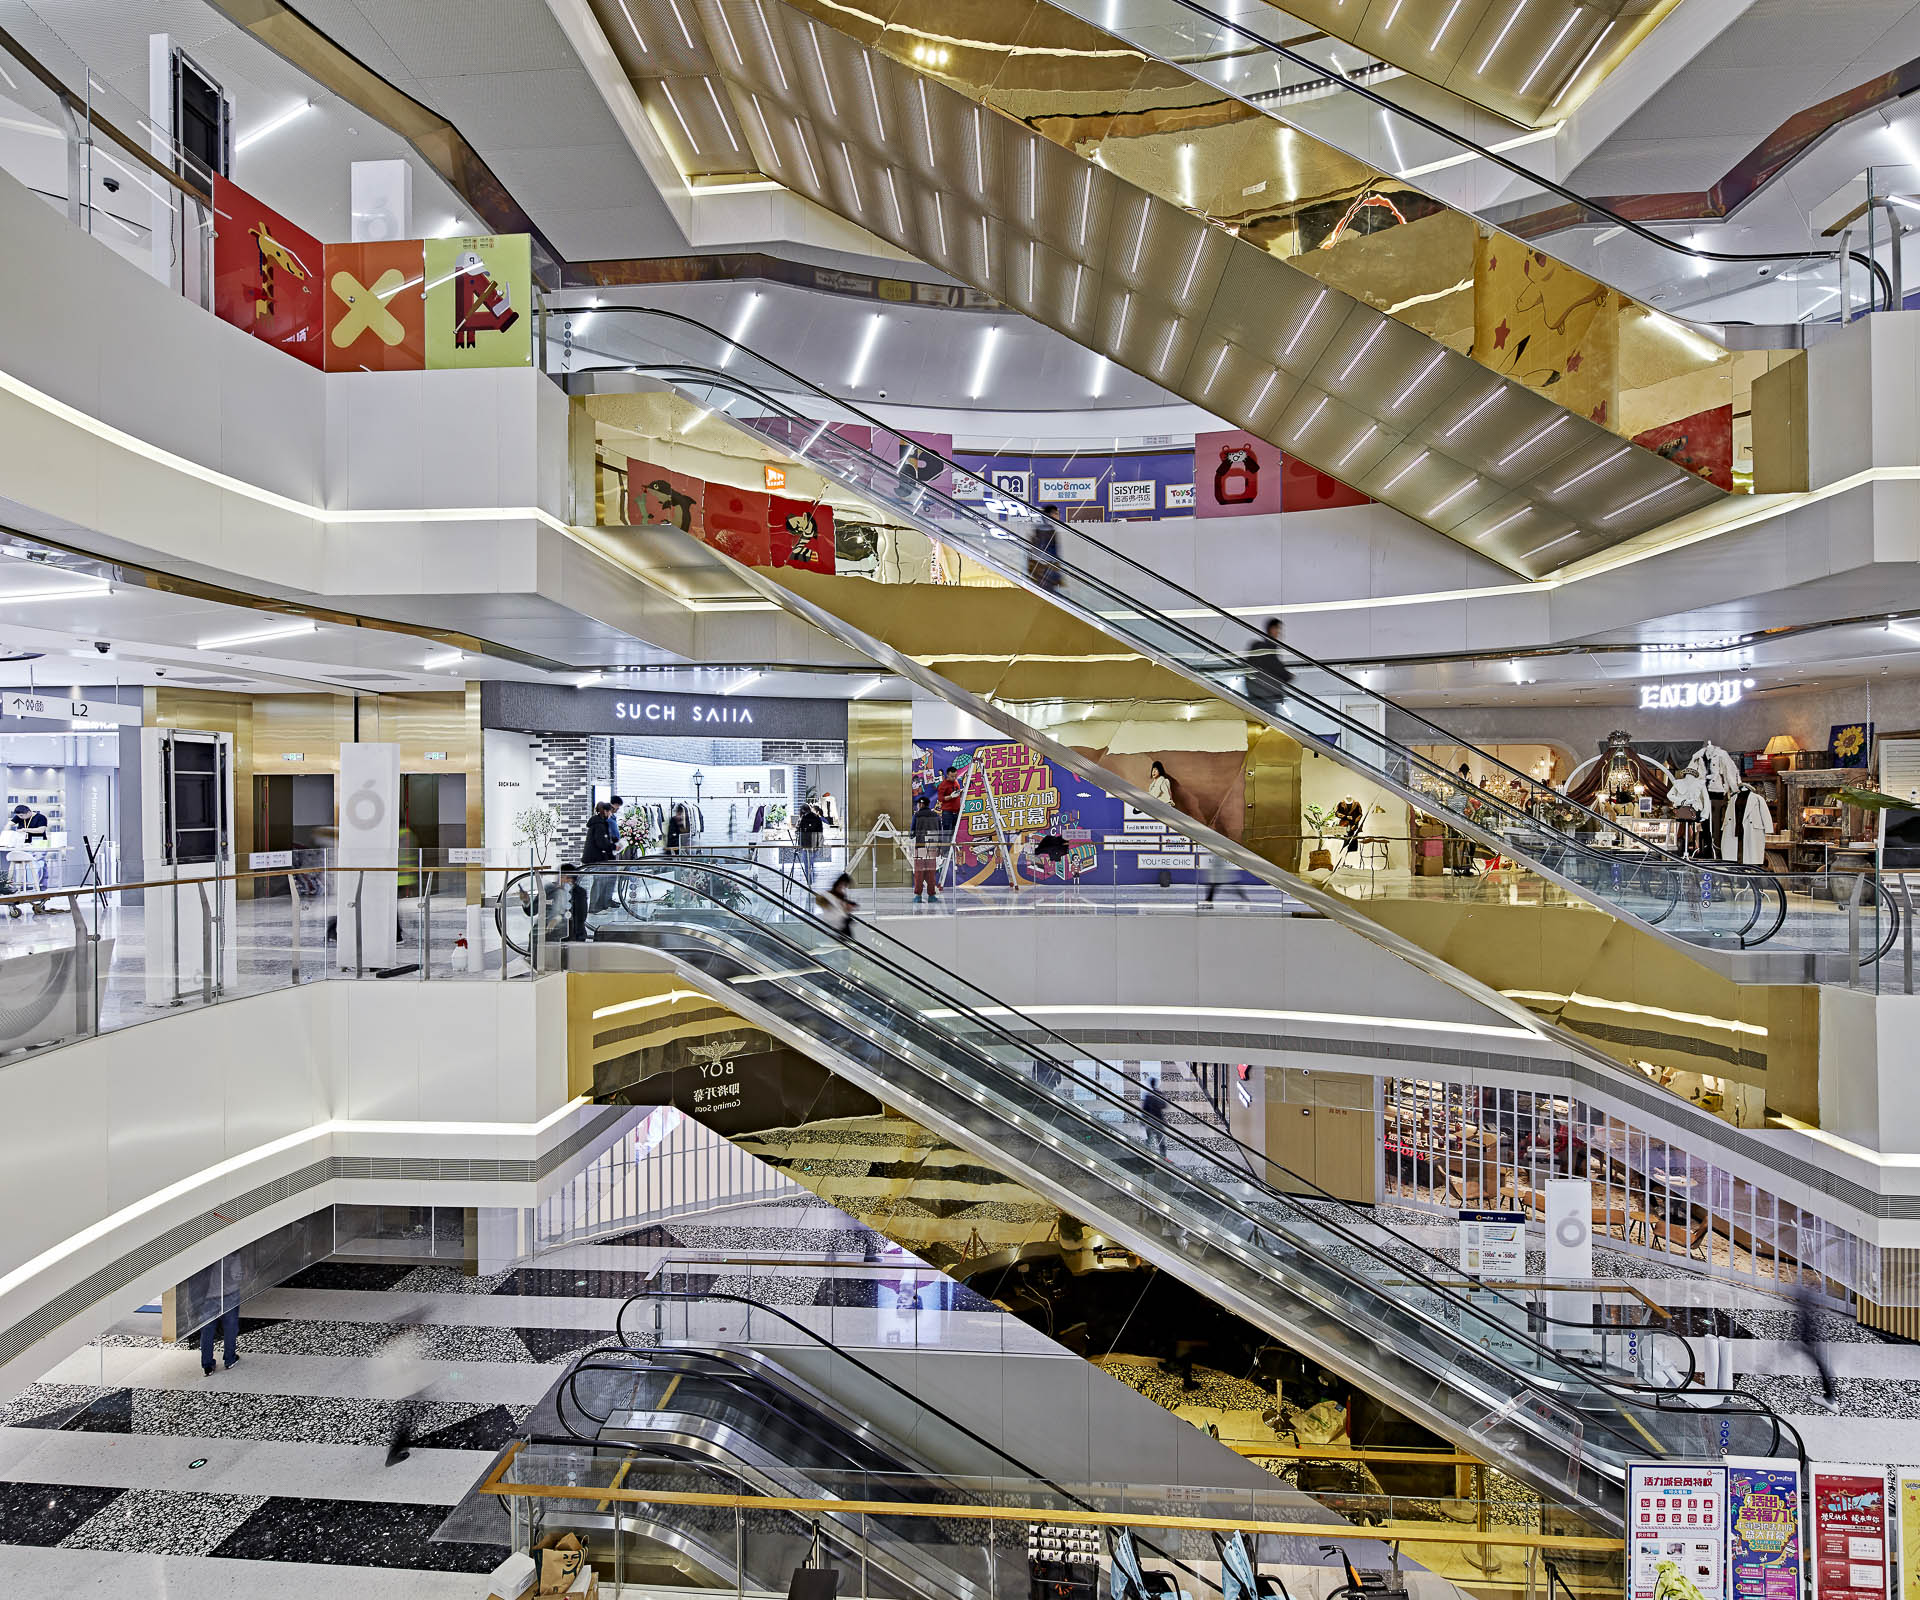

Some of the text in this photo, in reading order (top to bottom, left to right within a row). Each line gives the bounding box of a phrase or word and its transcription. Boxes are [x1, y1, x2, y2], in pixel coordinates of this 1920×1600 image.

[1043, 481, 1091, 491] babemax
[71, 702, 88, 717] L2
[616, 703, 676, 721] SUCH
[985, 745, 1030, 769] 活出
[966, 766, 1047, 797] 幸福力
[972, 807, 1046, 831] 盛大开幕
[1172, 858, 1191, 866] CHIC
[1644, 1476, 1713, 1487] 活力城会员特权
[1751, 1495, 1778, 1508] 活出
[1741, 1507, 1788, 1523] 幸福力
